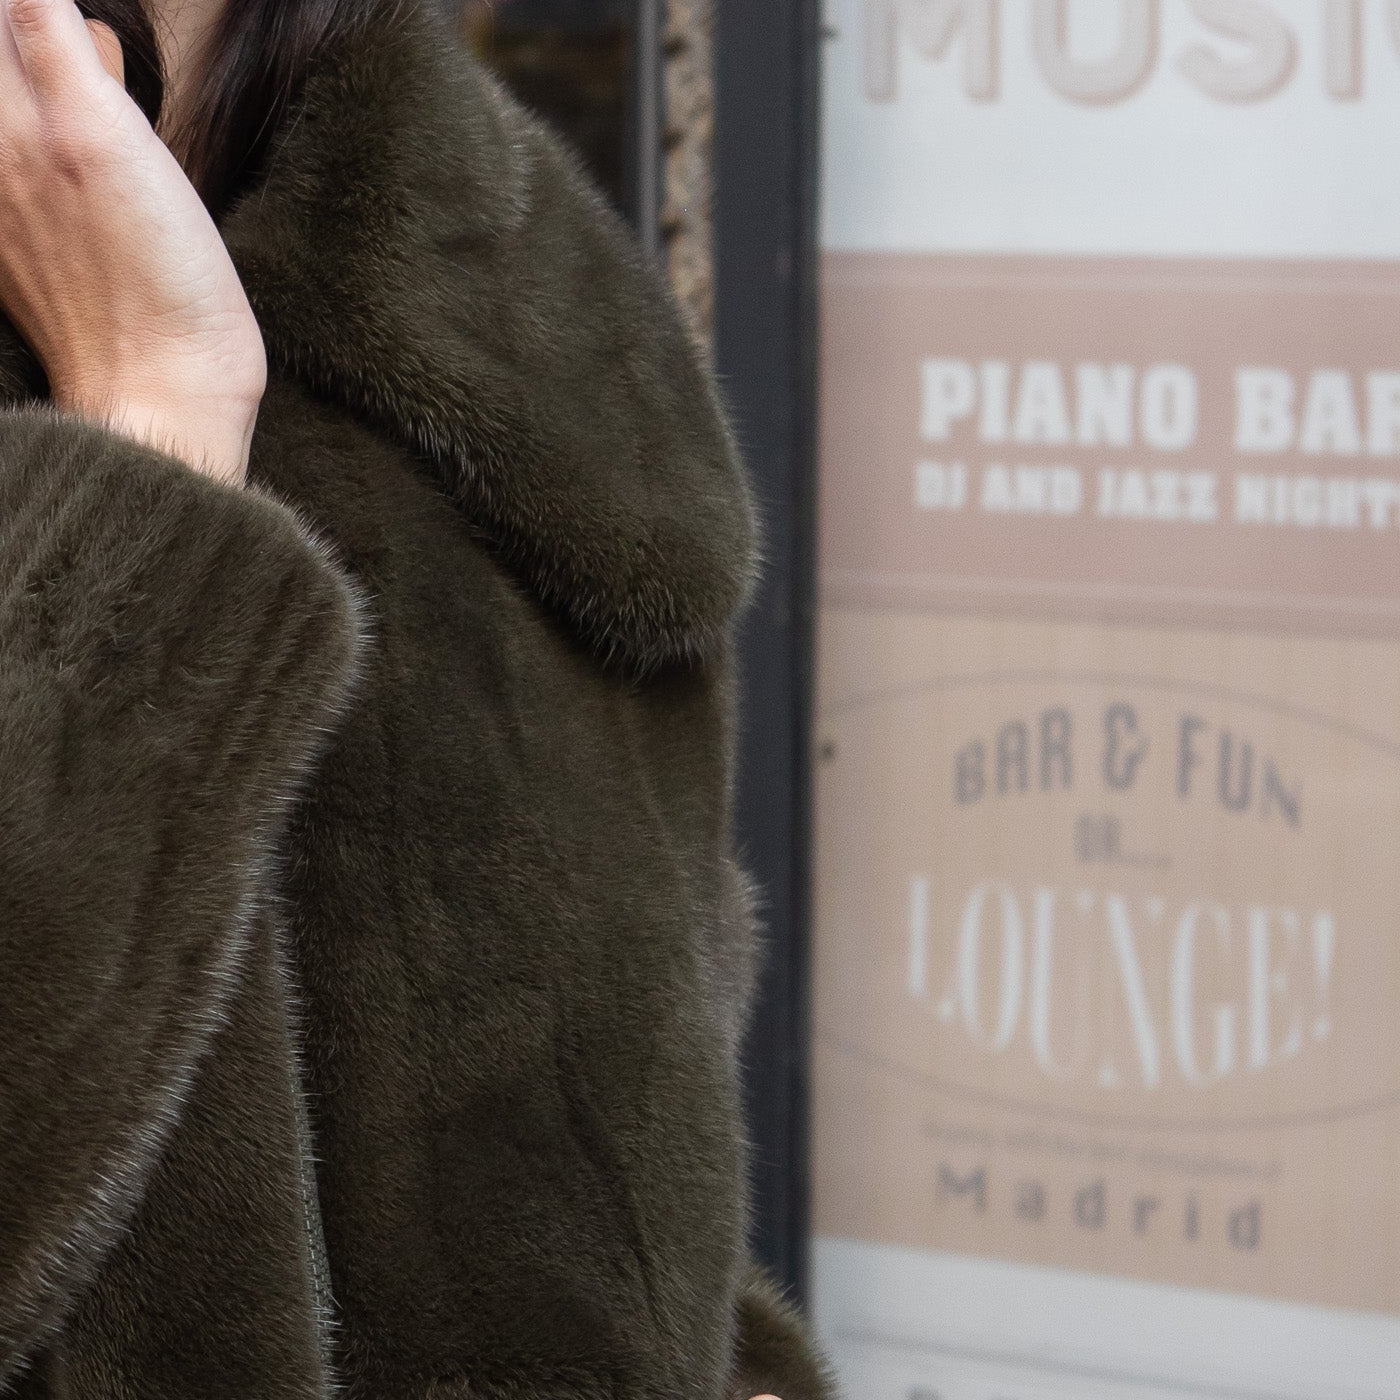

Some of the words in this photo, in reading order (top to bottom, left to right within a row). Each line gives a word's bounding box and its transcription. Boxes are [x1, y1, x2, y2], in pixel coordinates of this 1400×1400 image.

[919, 357, 1198, 450] PIANO
[980, 463, 1081, 515] AND
[1098, 467, 1218, 520] JAZZ
[1234, 472, 1400, 530] NIGHT
[953, 703, 1074, 807] BAR
[1102, 701, 1149, 791] &
[1175, 711, 1303, 832] FUN
[907, 873, 1336, 1090] LOUNGE!
[934, 1159, 1263, 1252] Madrid
